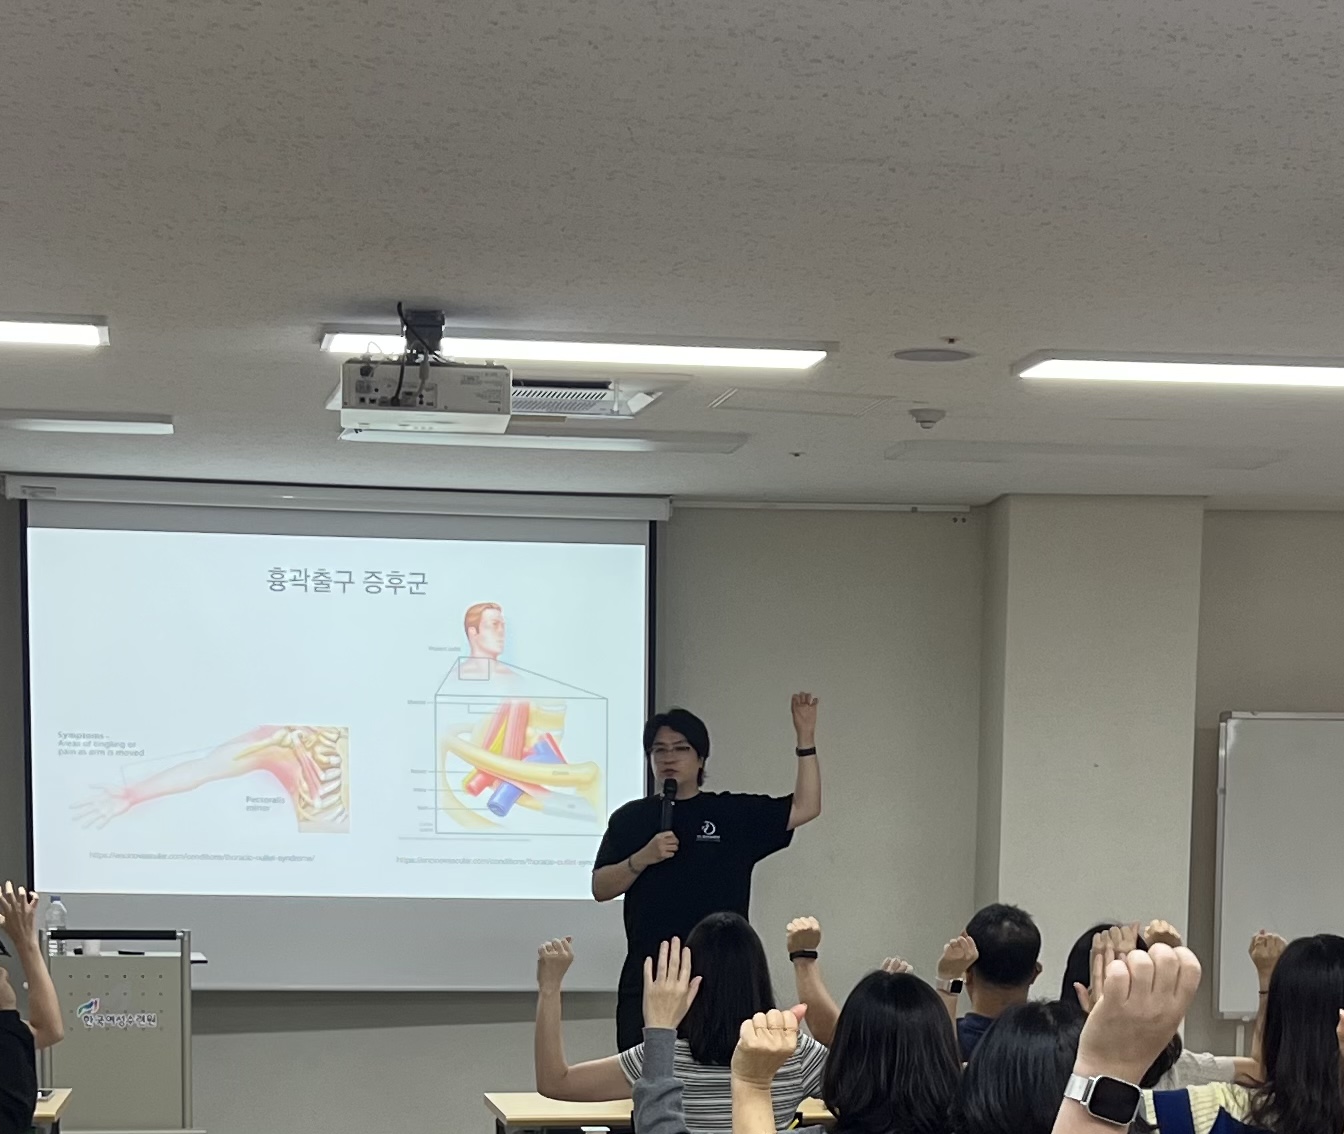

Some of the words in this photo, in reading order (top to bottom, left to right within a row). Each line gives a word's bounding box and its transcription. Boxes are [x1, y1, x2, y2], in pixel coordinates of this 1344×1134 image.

[266, 566, 356, 594] 흉곽출구
[362, 570, 429, 596] 증후군
[57, 731, 105, 740] Symptoms
